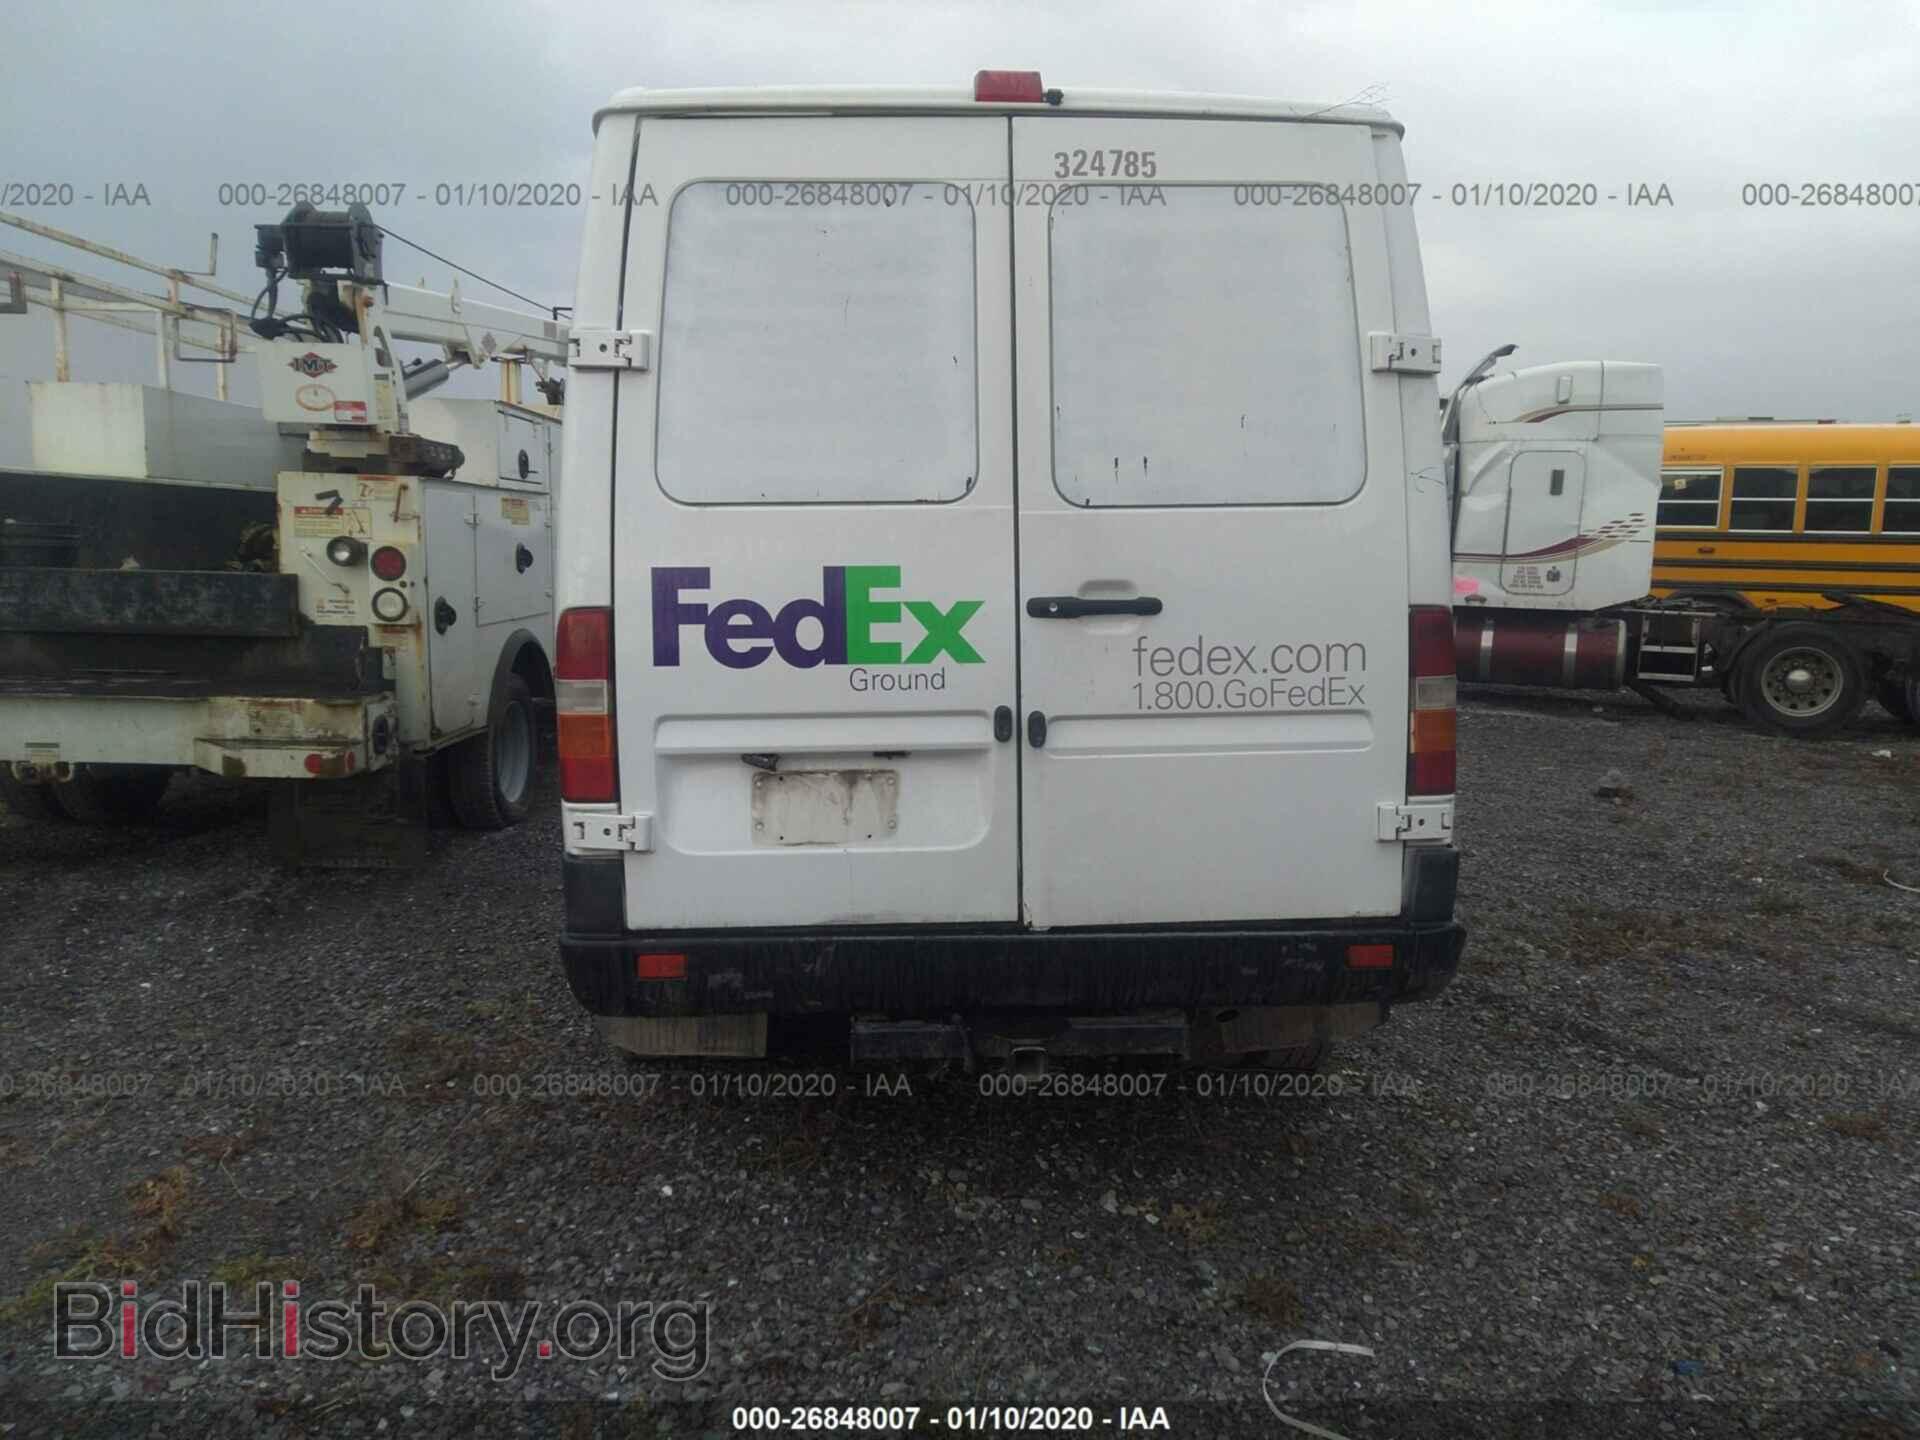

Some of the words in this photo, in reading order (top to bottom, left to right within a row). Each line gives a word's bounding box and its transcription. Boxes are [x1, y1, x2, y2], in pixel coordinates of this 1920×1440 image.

[1054, 149, 1157, 178] 324785
[651, 566, 986, 669] FedEx
[1132, 635, 1367, 677] fedex.com
[849, 667, 946, 691] Ground
[1133, 677, 1365, 710] 1.800.GoFedEx
